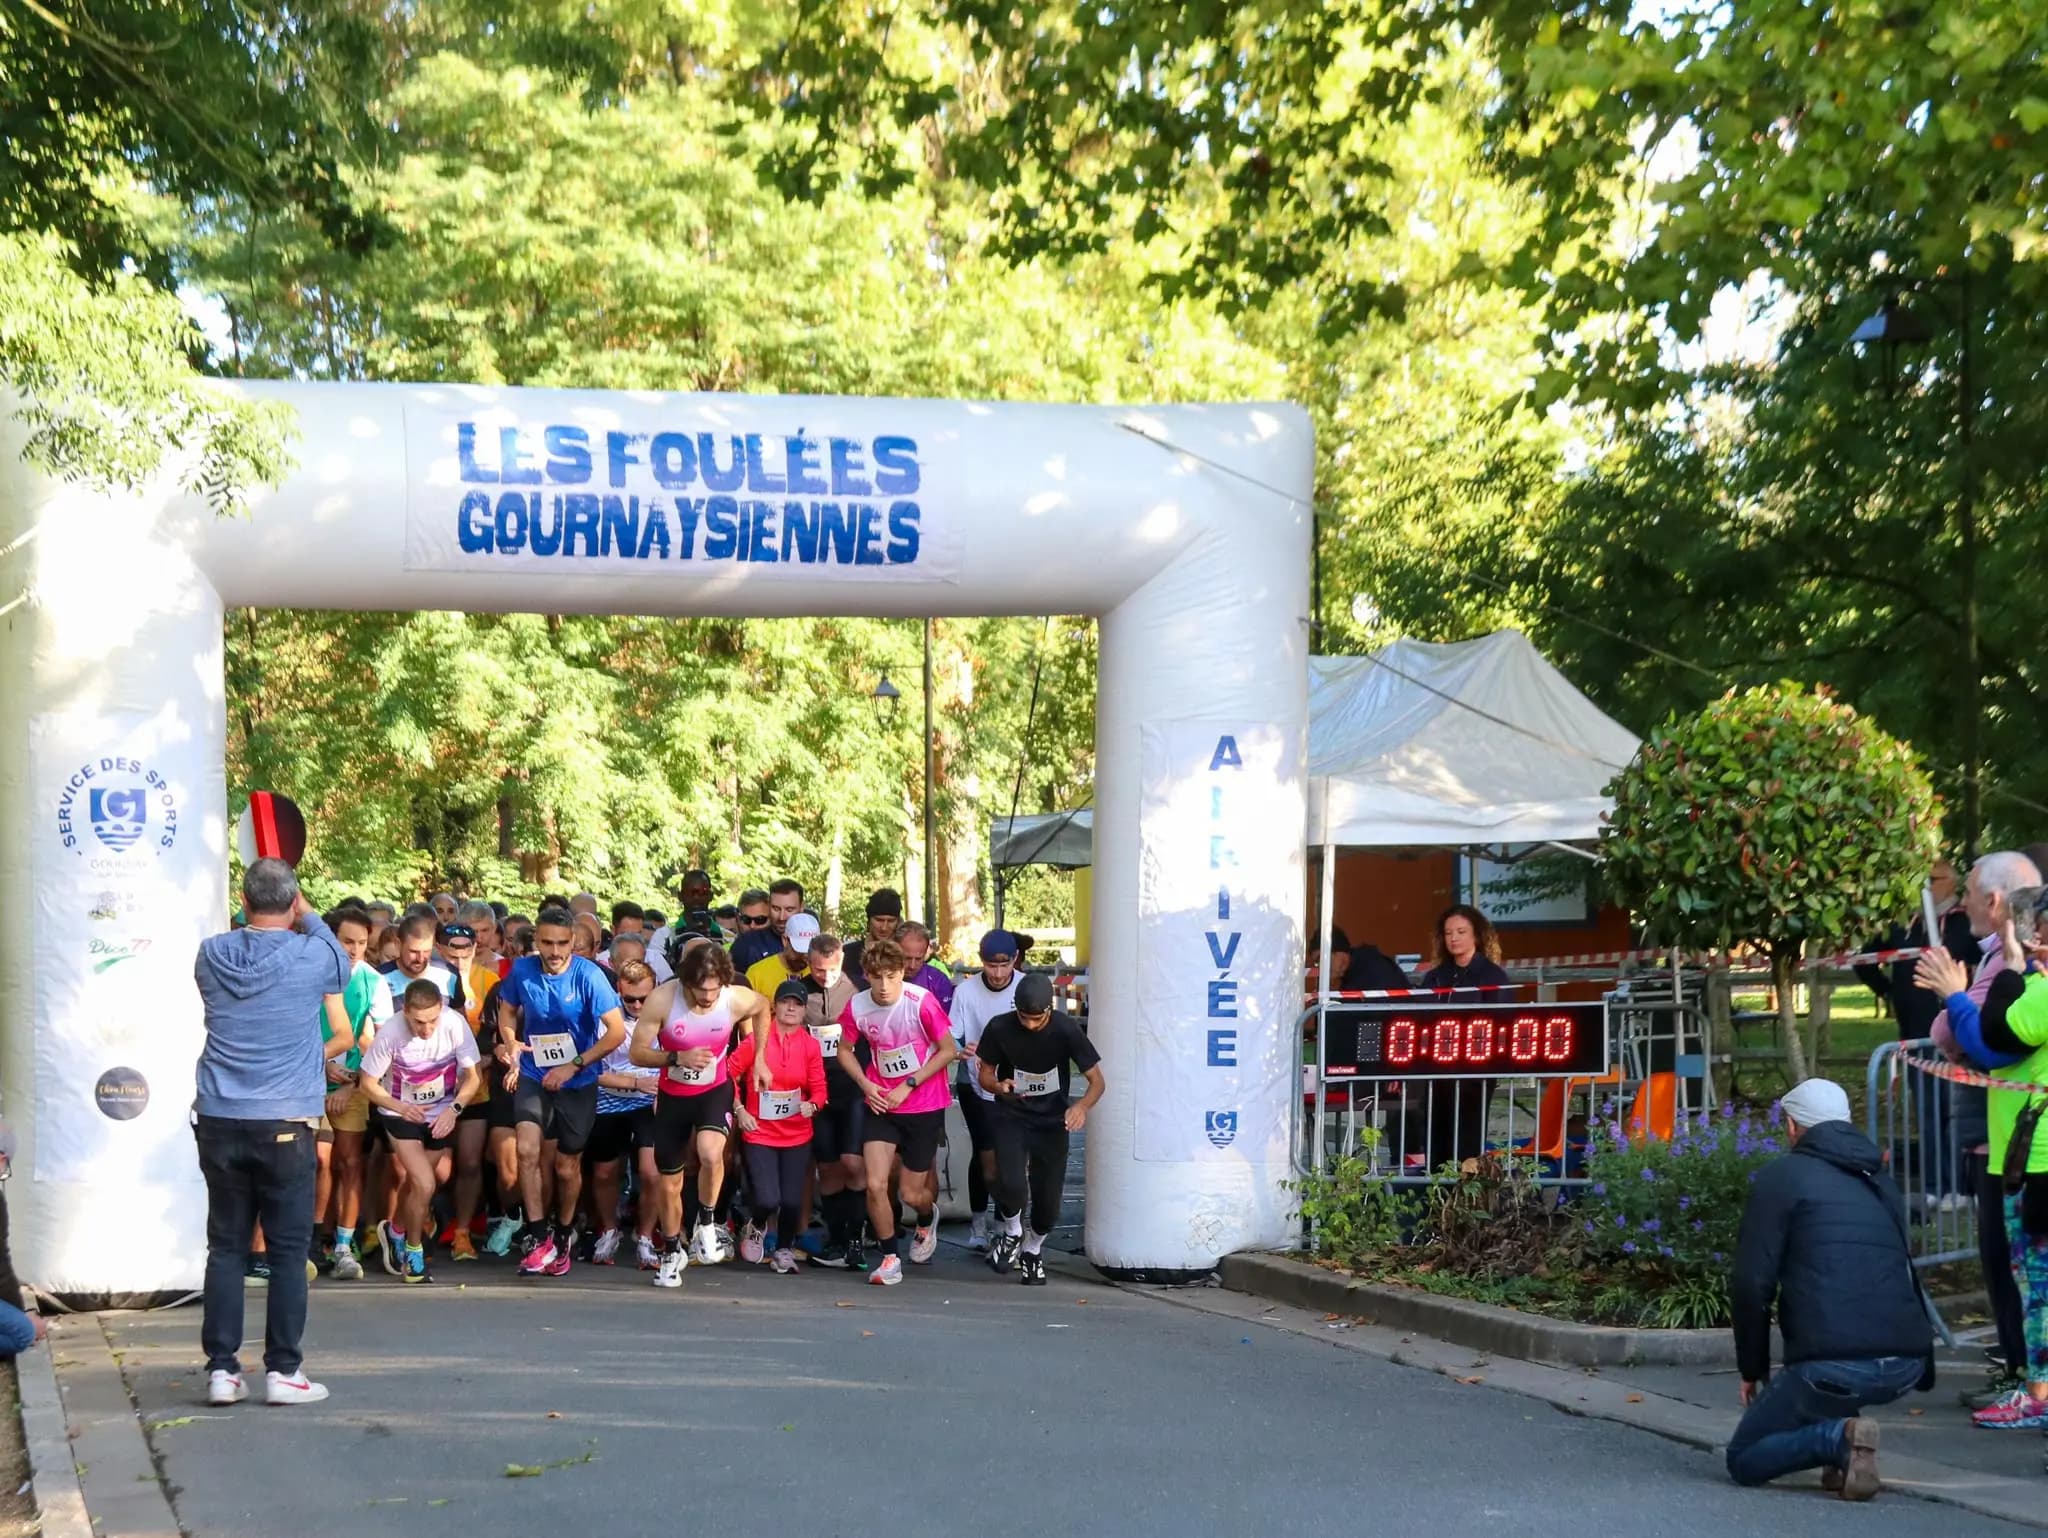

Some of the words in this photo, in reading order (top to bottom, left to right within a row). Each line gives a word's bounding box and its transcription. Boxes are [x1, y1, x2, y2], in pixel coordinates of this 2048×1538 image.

[457, 422, 593, 485] LES
[606, 427, 920, 496] FOULÉES
[457, 489, 921, 565] GOURNAYSIENNES
[58, 764, 97, 848] SERVICE
[100, 756, 142, 774] DES
[145, 769, 177, 849] SPORTS
[1204, 735, 1243, 1067] AIVÉE
[543, 1048, 565, 1060] 161
[1387, 1017, 1572, 1063] 0:00:00
[683, 1070, 700, 1081] 53
[885, 1060, 909, 1073] 118
[1028, 1083, 1046, 1092] 86
[774, 1103, 790, 1115] 75
